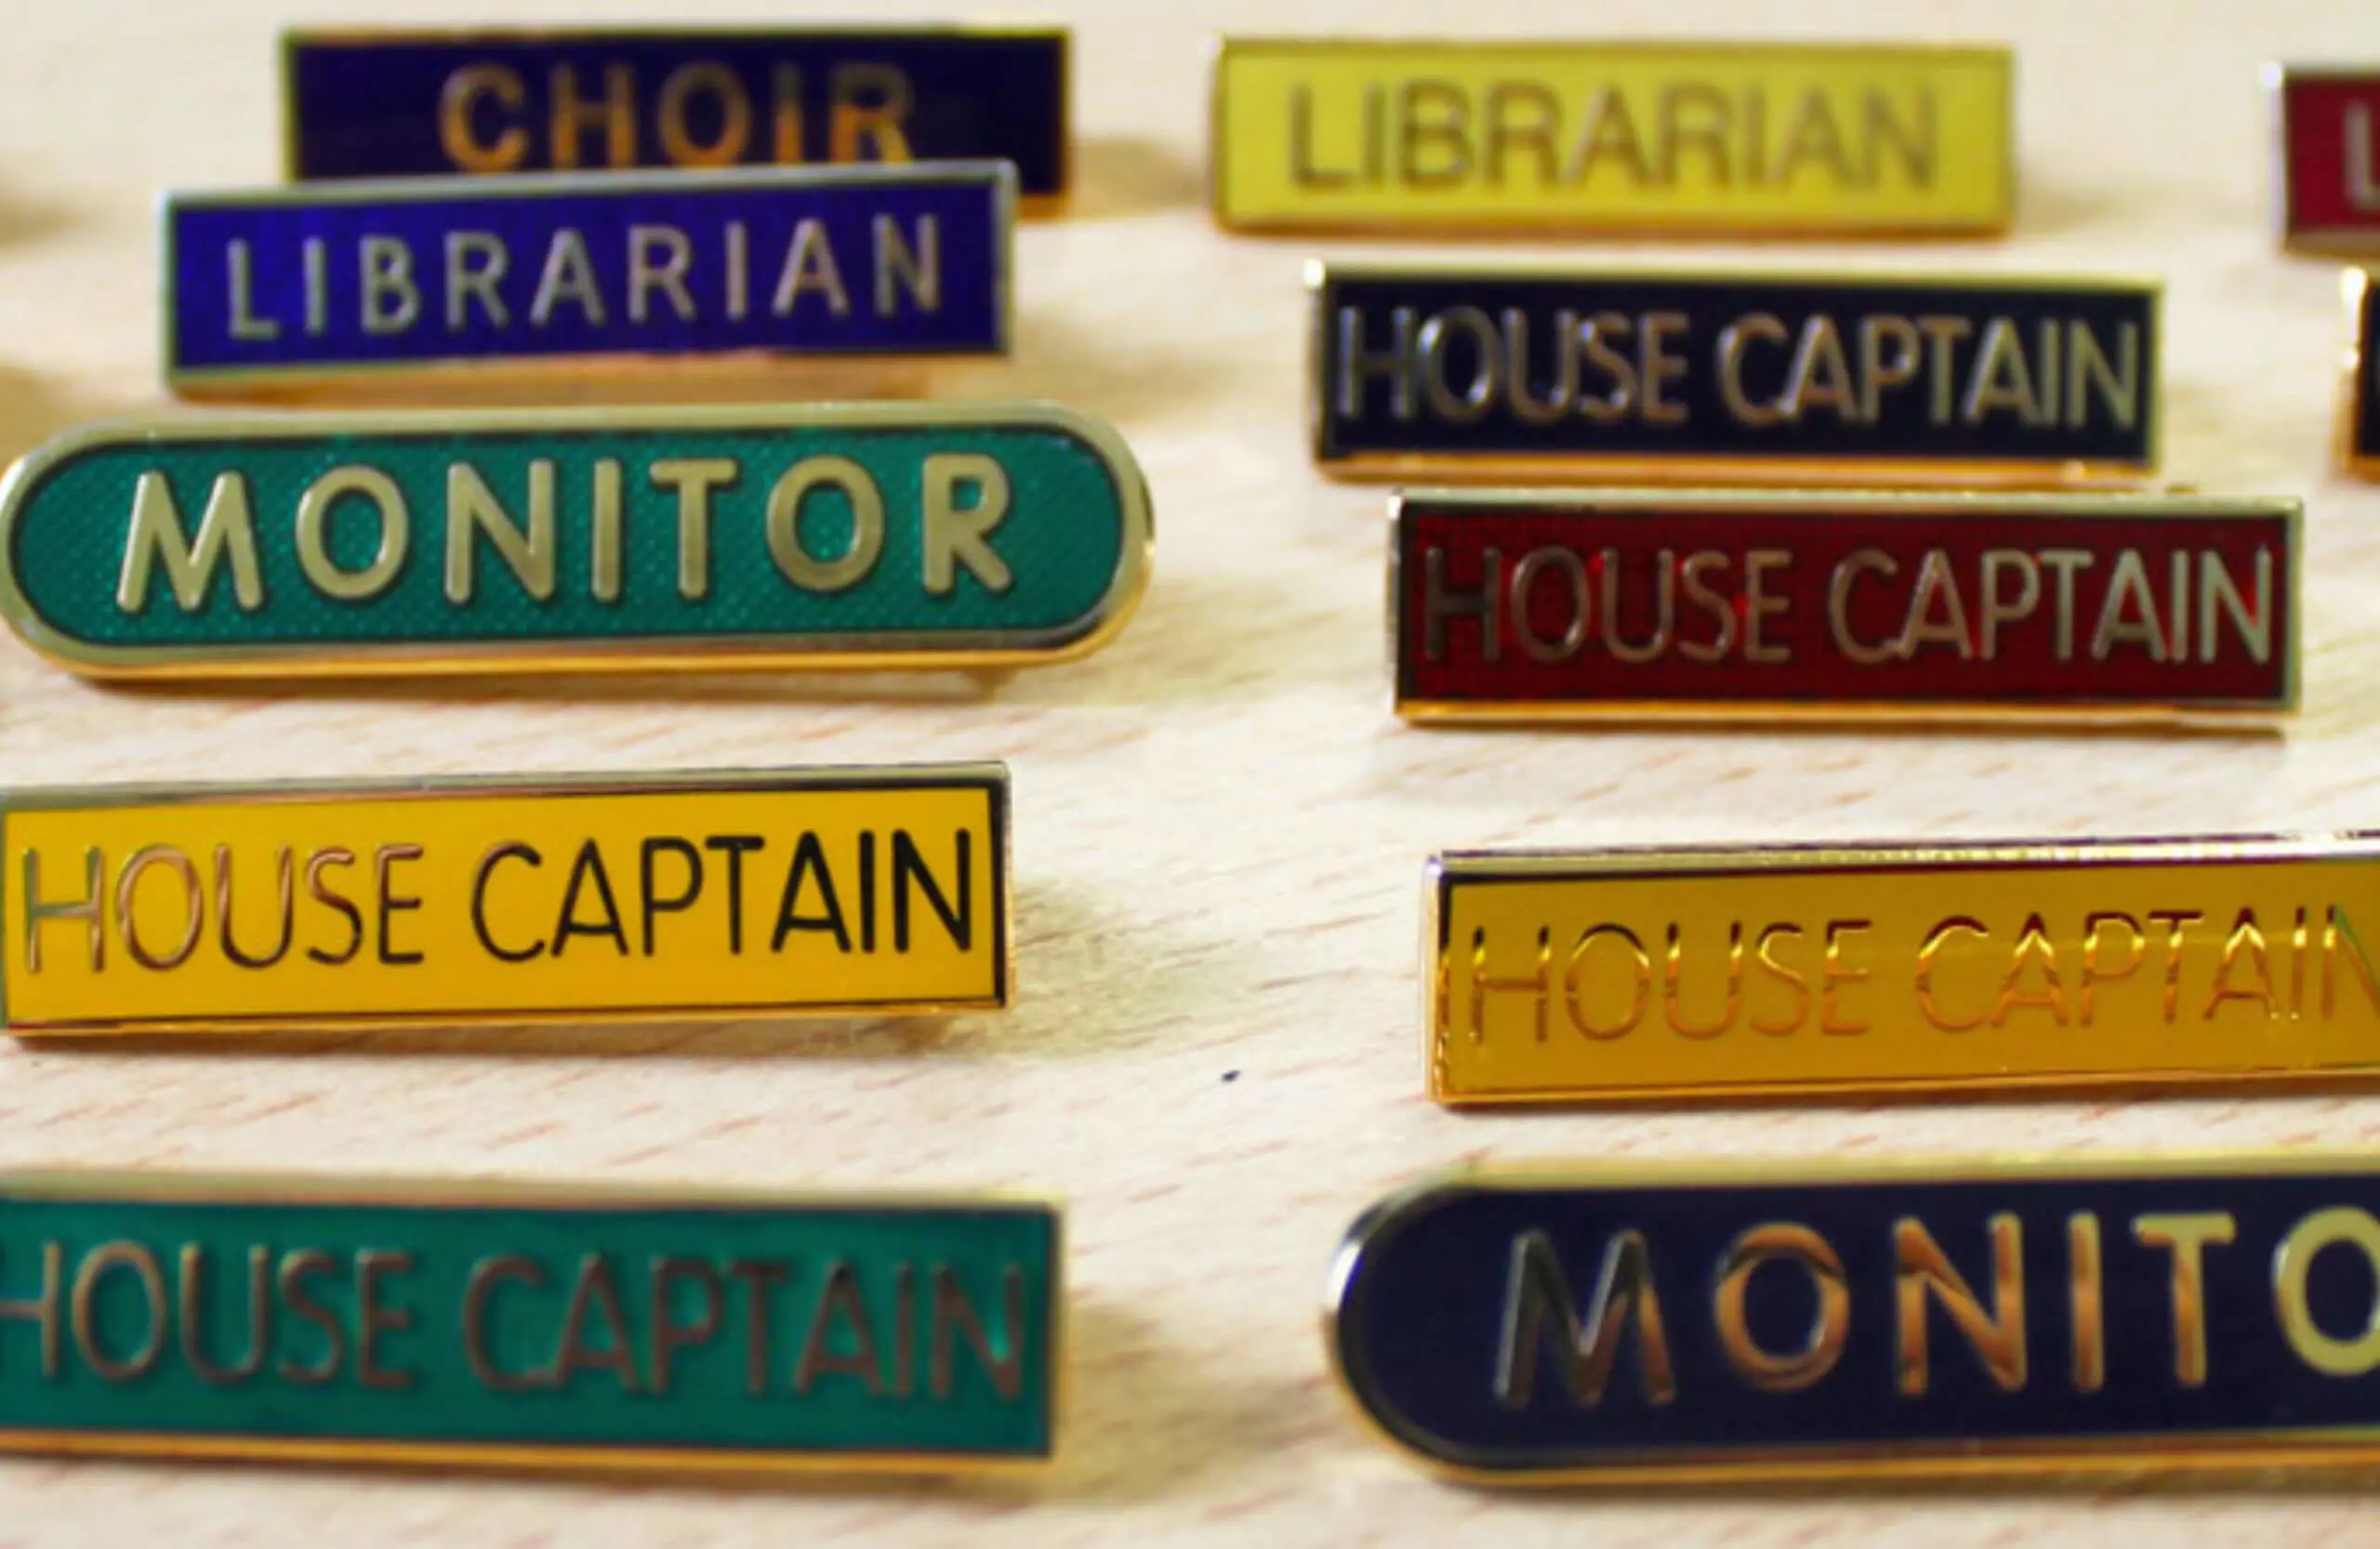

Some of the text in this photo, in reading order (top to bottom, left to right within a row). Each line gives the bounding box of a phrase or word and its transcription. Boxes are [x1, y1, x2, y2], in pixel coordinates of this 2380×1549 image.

[436, 63, 920, 173] CHOIR
[1288, 80, 1939, 192] LIBRARIAN
[225, 214, 945, 340] LIBRARIAN
[1337, 307, 2138, 430] HOUSE CAPTAIN
[116, 453, 1012, 616] MONITOR
[1420, 543, 2274, 666] HOUSE CAPTAIN
[20, 827, 973, 973] HOUSE CAPTAIN
[1469, 919, 1874, 1043] HOUSE
[461, 1251, 1027, 1402] CAPTAIN
